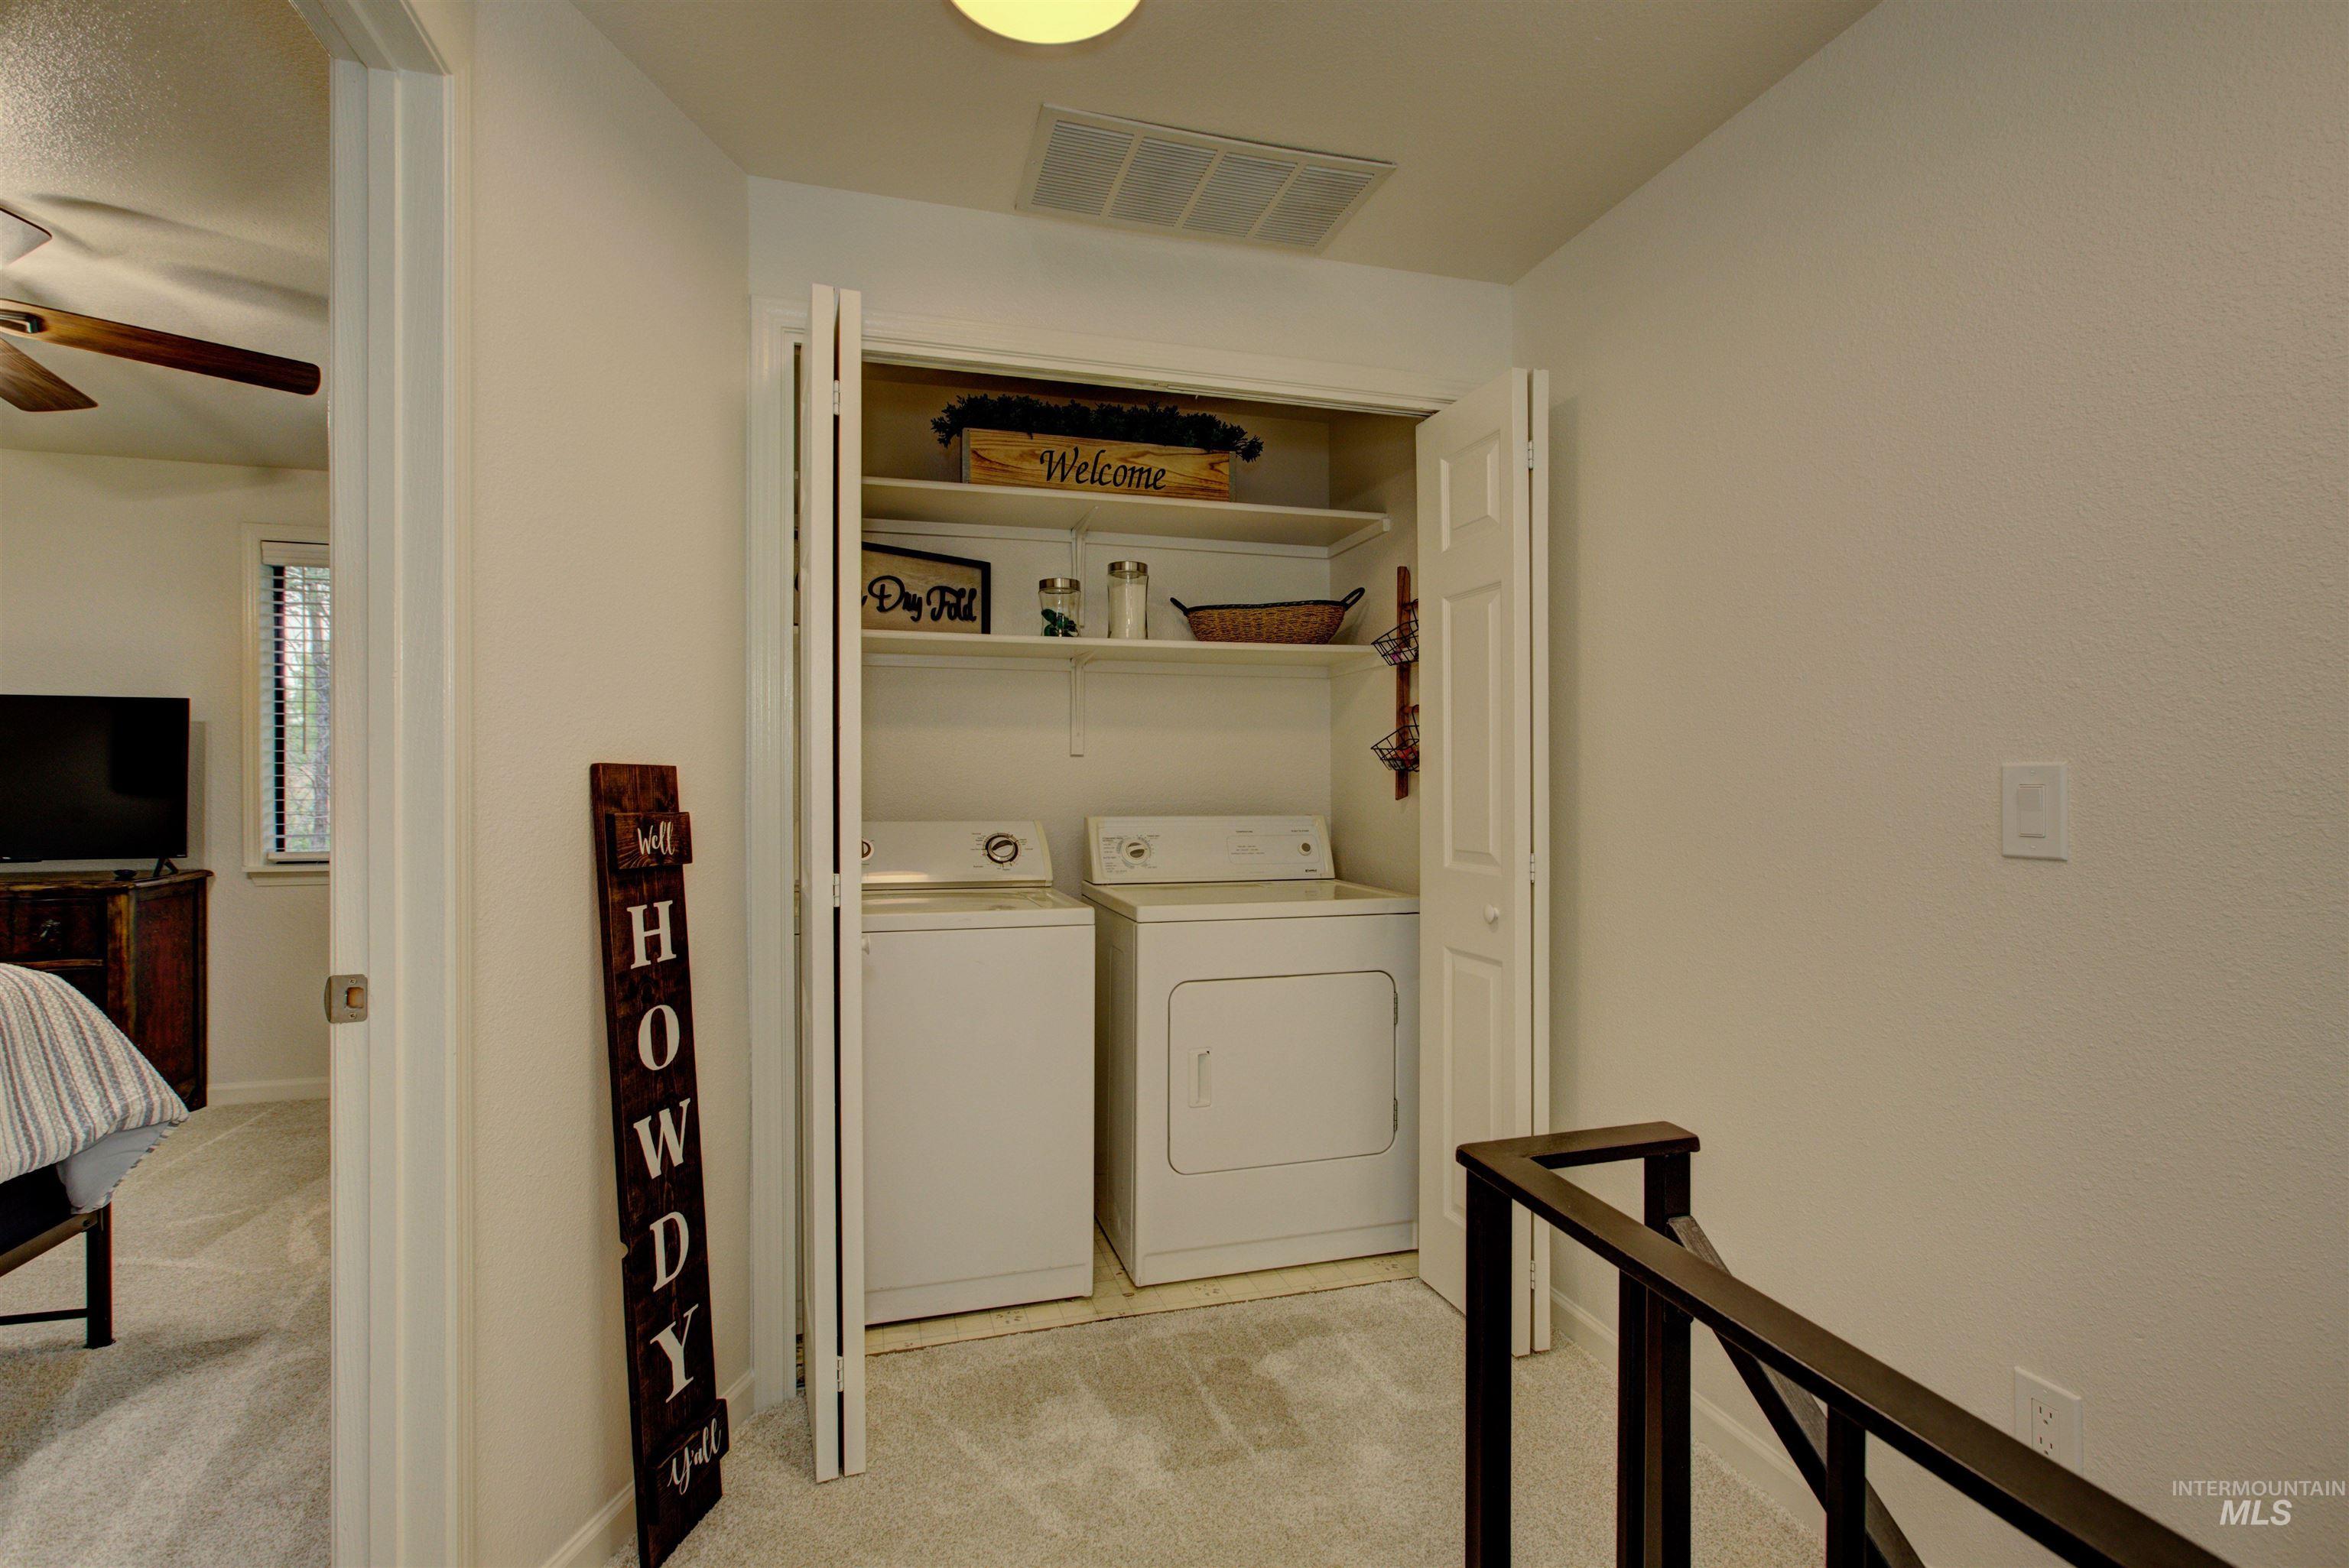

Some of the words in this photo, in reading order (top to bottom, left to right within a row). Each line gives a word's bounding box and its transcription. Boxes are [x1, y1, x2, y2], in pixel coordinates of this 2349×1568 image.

[1040, 446, 1166, 490] Welcome
[868, 575, 922, 622] Dry
[926, 586, 977, 622] Fold
[638, 820, 676, 855] Well
[626, 900, 699, 1404] HOWDY
[667, 1417, 722, 1495] Y'all
